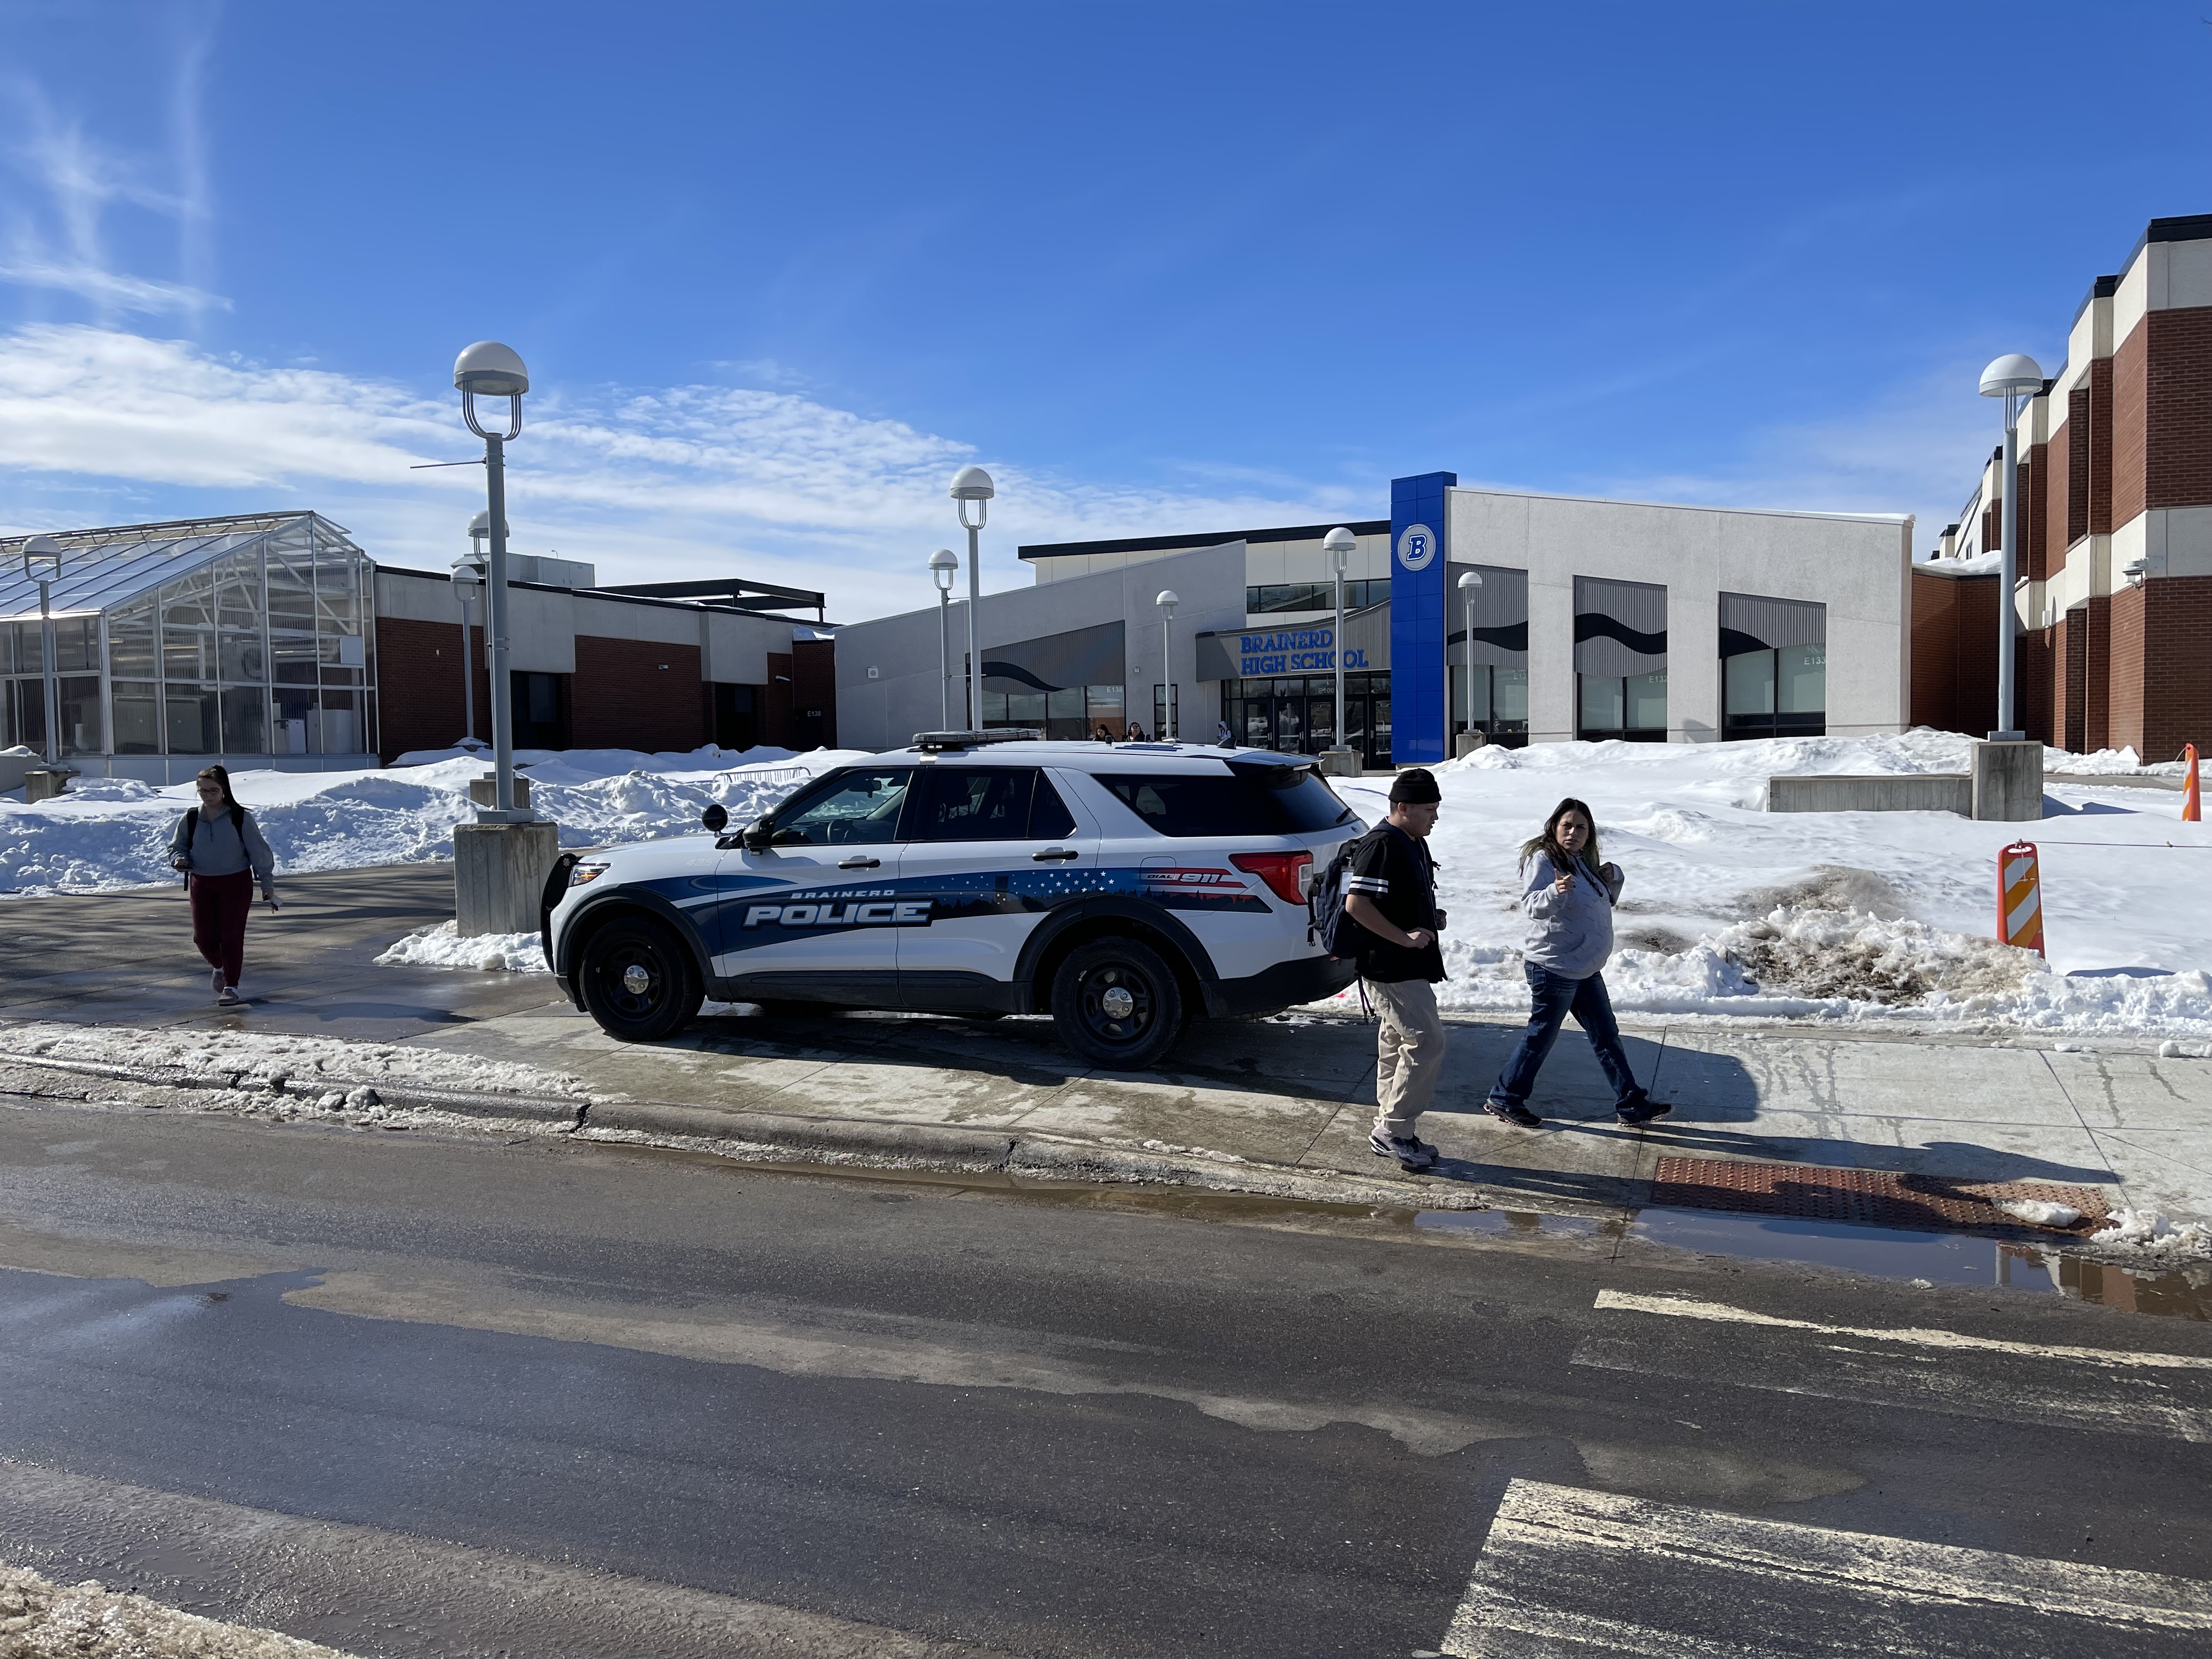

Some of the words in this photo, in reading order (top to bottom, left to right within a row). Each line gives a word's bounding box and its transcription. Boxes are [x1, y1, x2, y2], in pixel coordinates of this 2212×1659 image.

[1406, 534, 1427, 561] B
[1240, 630, 1333, 653] BRAINERD
[1242, 655, 1286, 675] HIGH
[1291, 650, 1368, 669] SCHOOL
[1804, 656, 1826, 665] E133
[686, 858, 714, 867] 435
[1180, 873, 1220, 883] 911
[790, 889, 895, 899] BRAINERD
[743, 901, 932, 927] POLICE
